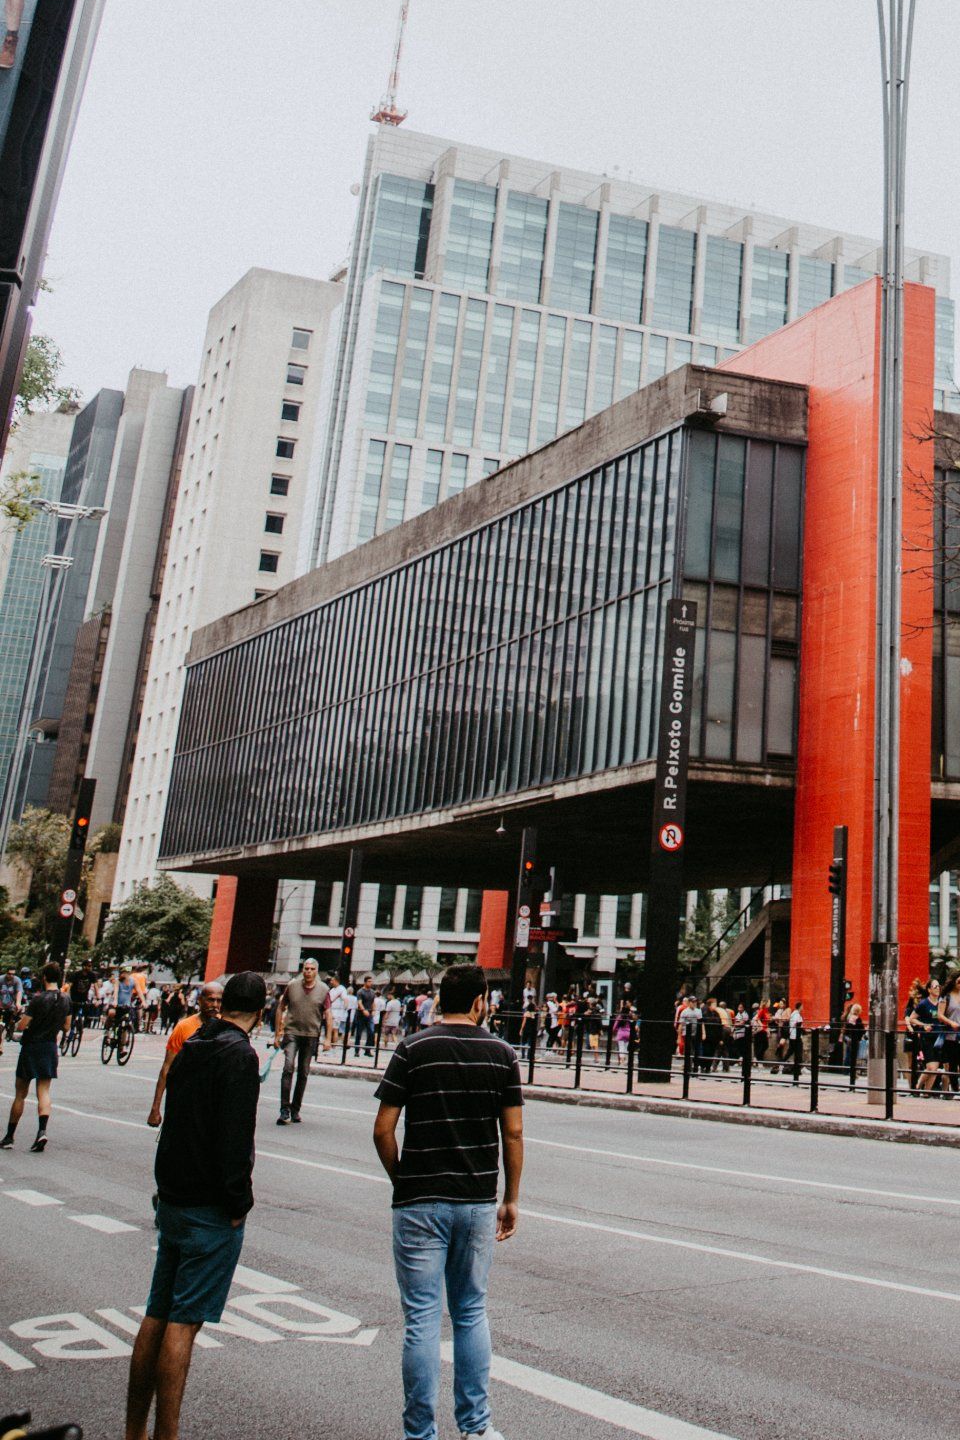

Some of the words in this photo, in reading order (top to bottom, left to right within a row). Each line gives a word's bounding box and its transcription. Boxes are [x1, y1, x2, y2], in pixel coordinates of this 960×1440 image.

[669, 647, 686, 713] Gomide
[664, 720, 682, 789] Peixoto
[663, 793, 677, 810] R.
